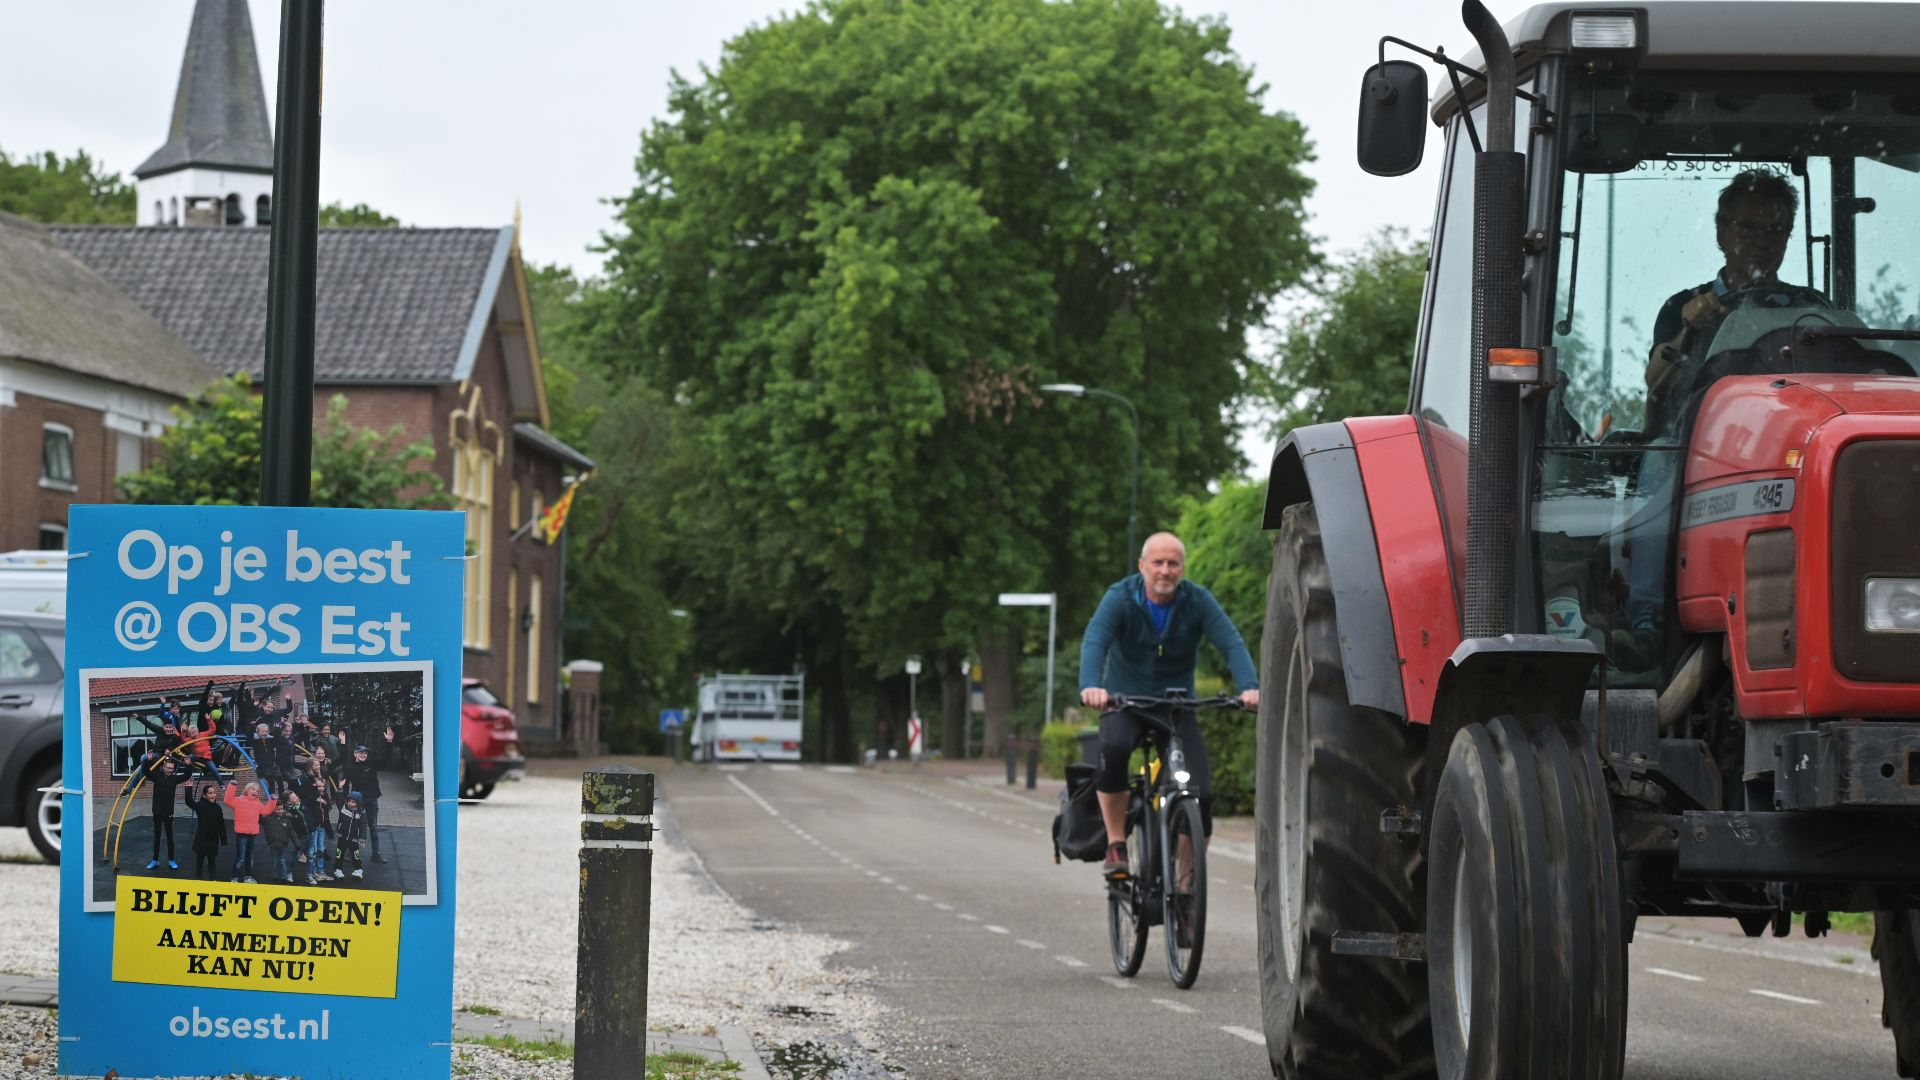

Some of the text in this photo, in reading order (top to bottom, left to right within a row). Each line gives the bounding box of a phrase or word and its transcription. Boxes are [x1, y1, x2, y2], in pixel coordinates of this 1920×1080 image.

[1753, 483, 1783, 511] 4345
[118, 529, 411, 596] Op je best
[115, 601, 410, 656] @ OBS Est
[131, 888, 382, 927] BLIJFT OPEN!
[157, 928, 351, 958] AANMELDEN
[187, 954, 315, 981] KAN NU!
[169, 1006, 329, 1041] obsest.nl
